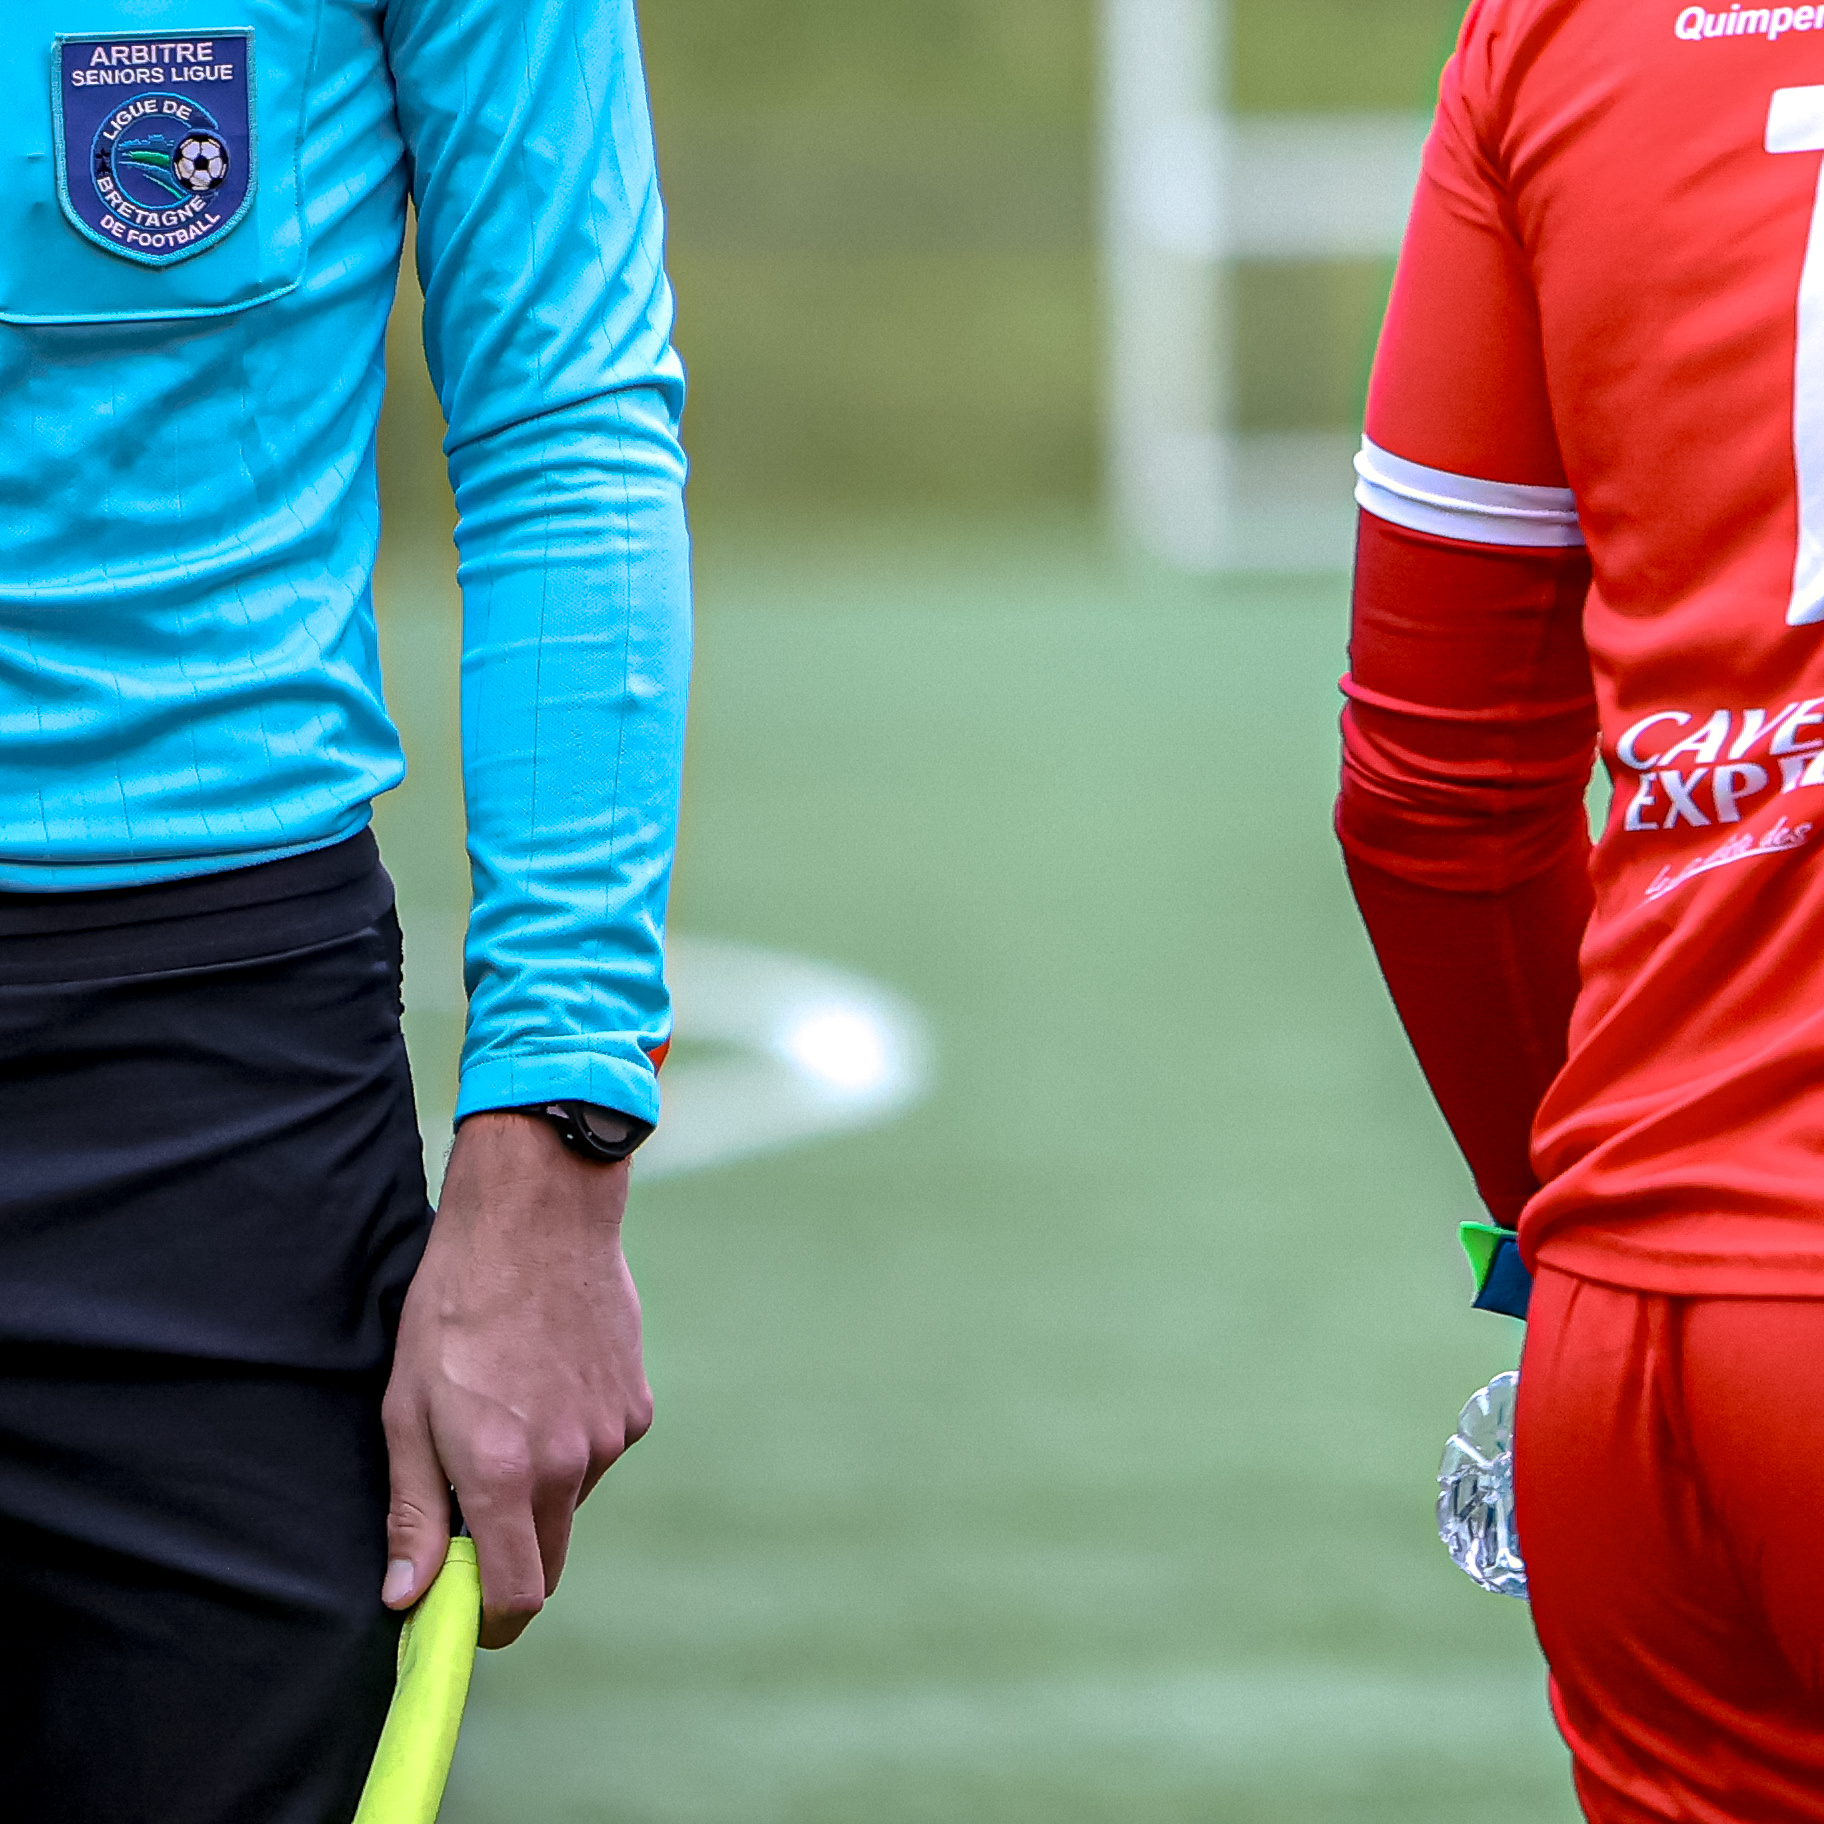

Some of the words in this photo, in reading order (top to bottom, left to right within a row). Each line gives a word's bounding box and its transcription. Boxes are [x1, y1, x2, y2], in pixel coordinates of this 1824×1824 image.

[90, 41, 213, 67] ARBITRE
[71, 67, 165, 87] SENIORS
[170, 64, 233, 83] LIGUE
[103, 99, 159, 141] LIGUE
[162, 100, 192, 121] DE
[97, 176, 206, 227] BRETAGNE
[100, 214, 124, 238] DE
[126, 212, 221, 248] FOOTBALL
